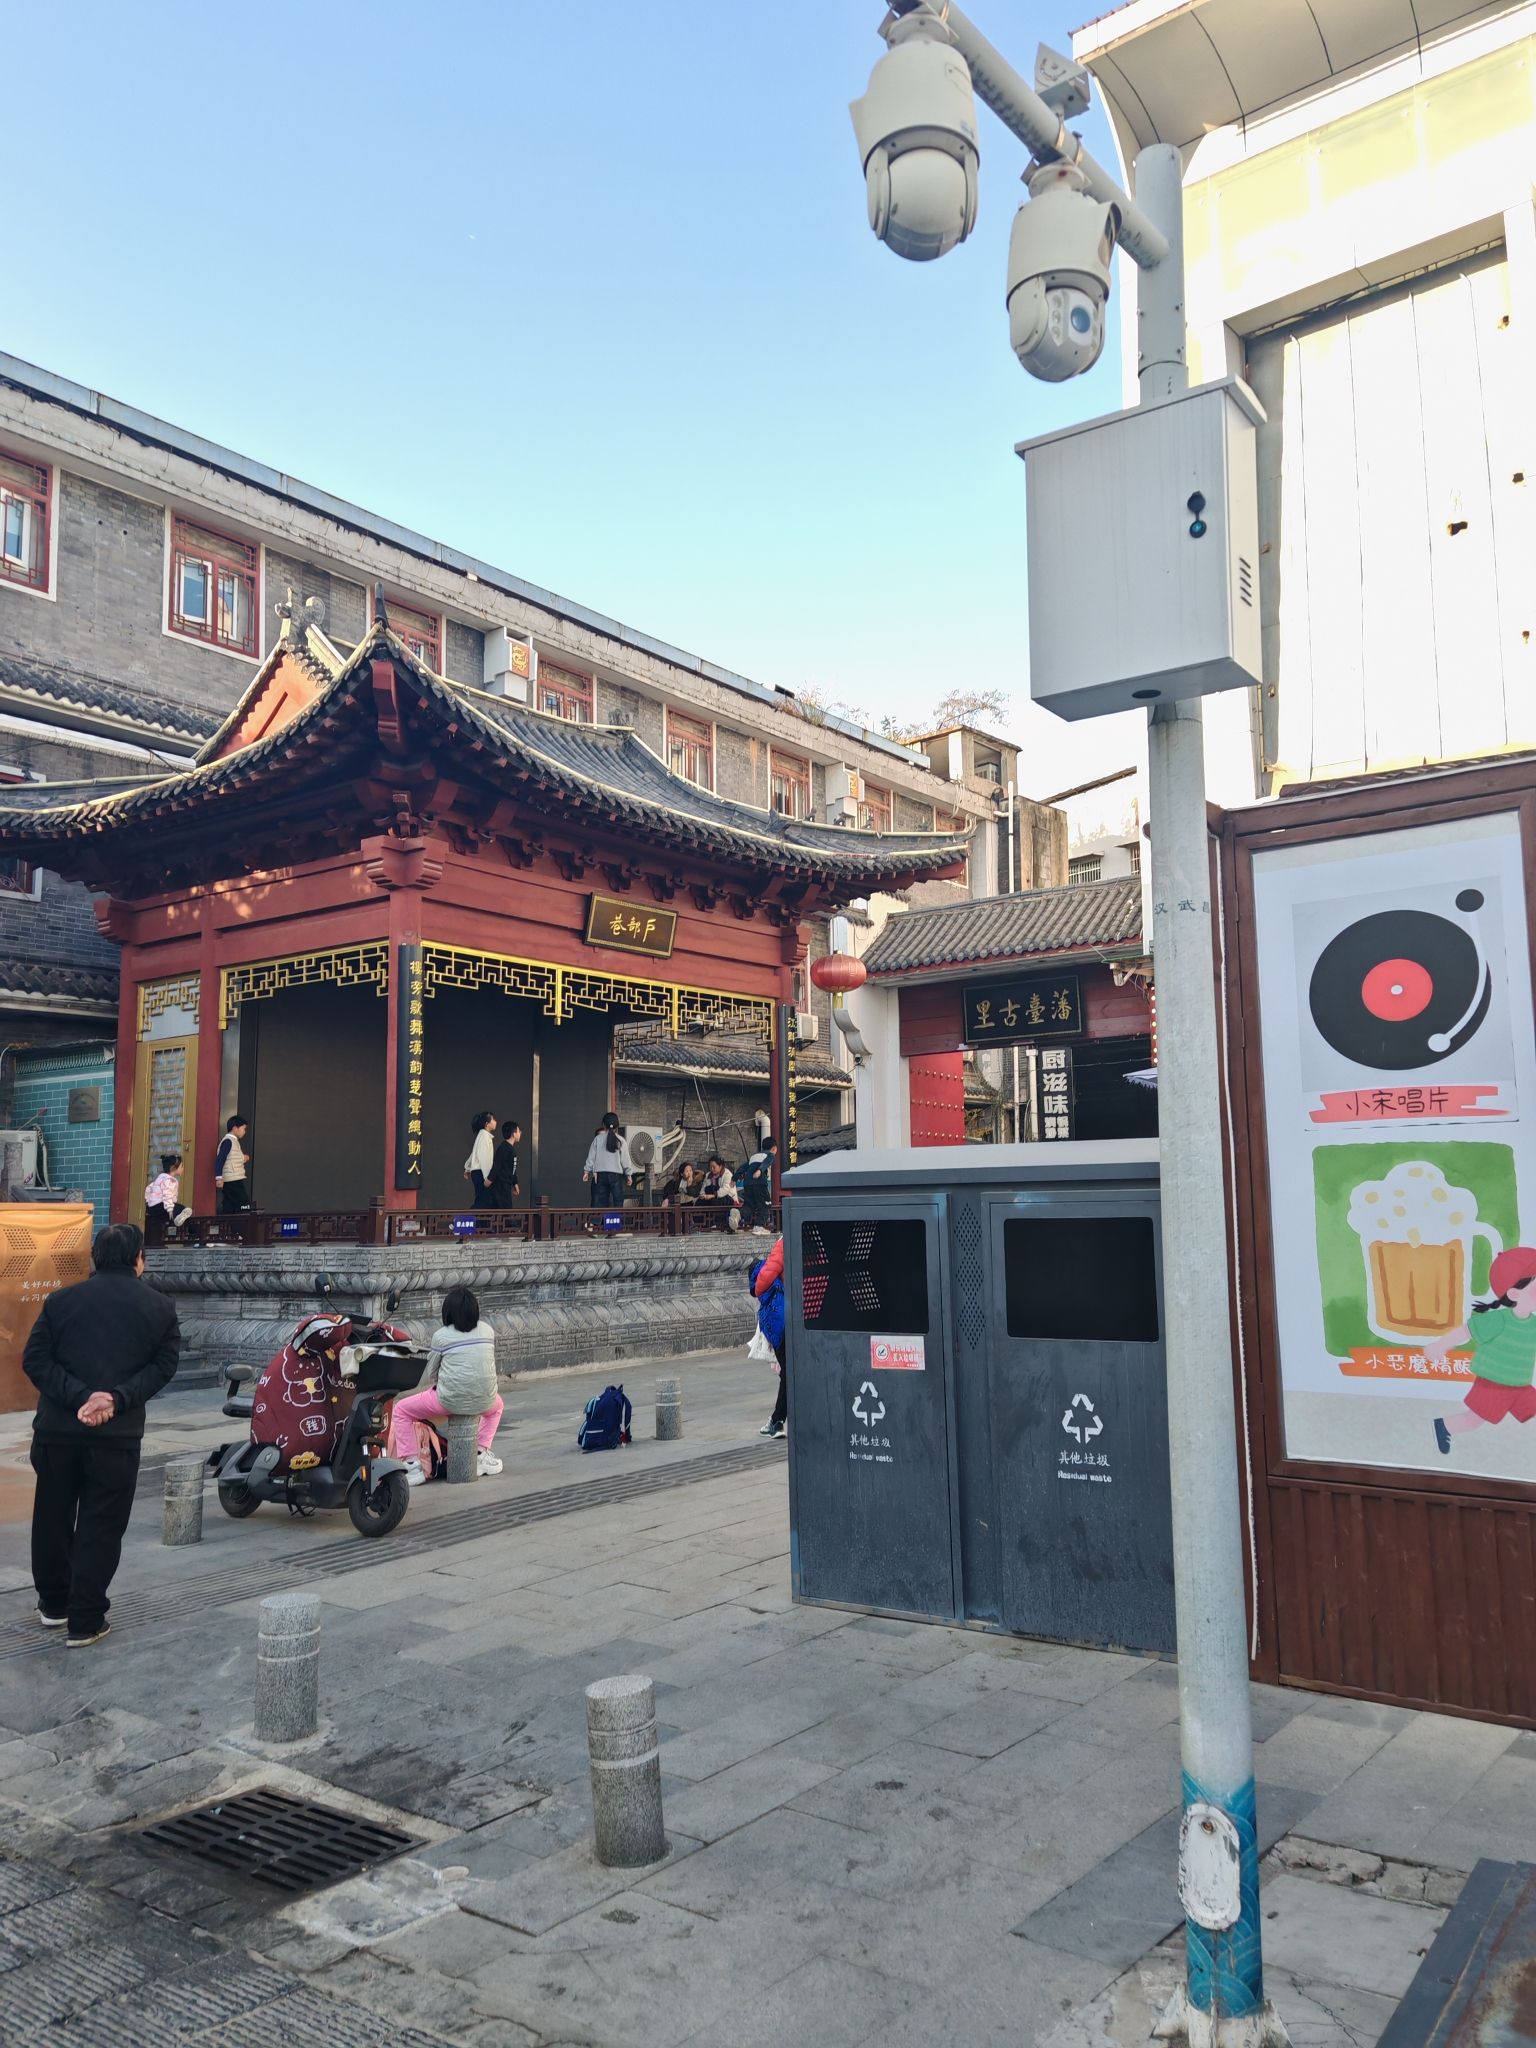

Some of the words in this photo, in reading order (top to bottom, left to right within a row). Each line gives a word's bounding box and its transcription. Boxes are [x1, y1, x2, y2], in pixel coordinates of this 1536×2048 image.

[1042, 1049, 1069, 1114] 厨滋味
[1345, 1086, 1450, 1117] 小宋唱片
[849, 1433, 892, 1448] 其他垃圾
[1058, 1450, 1111, 1467] 其他垃圾
